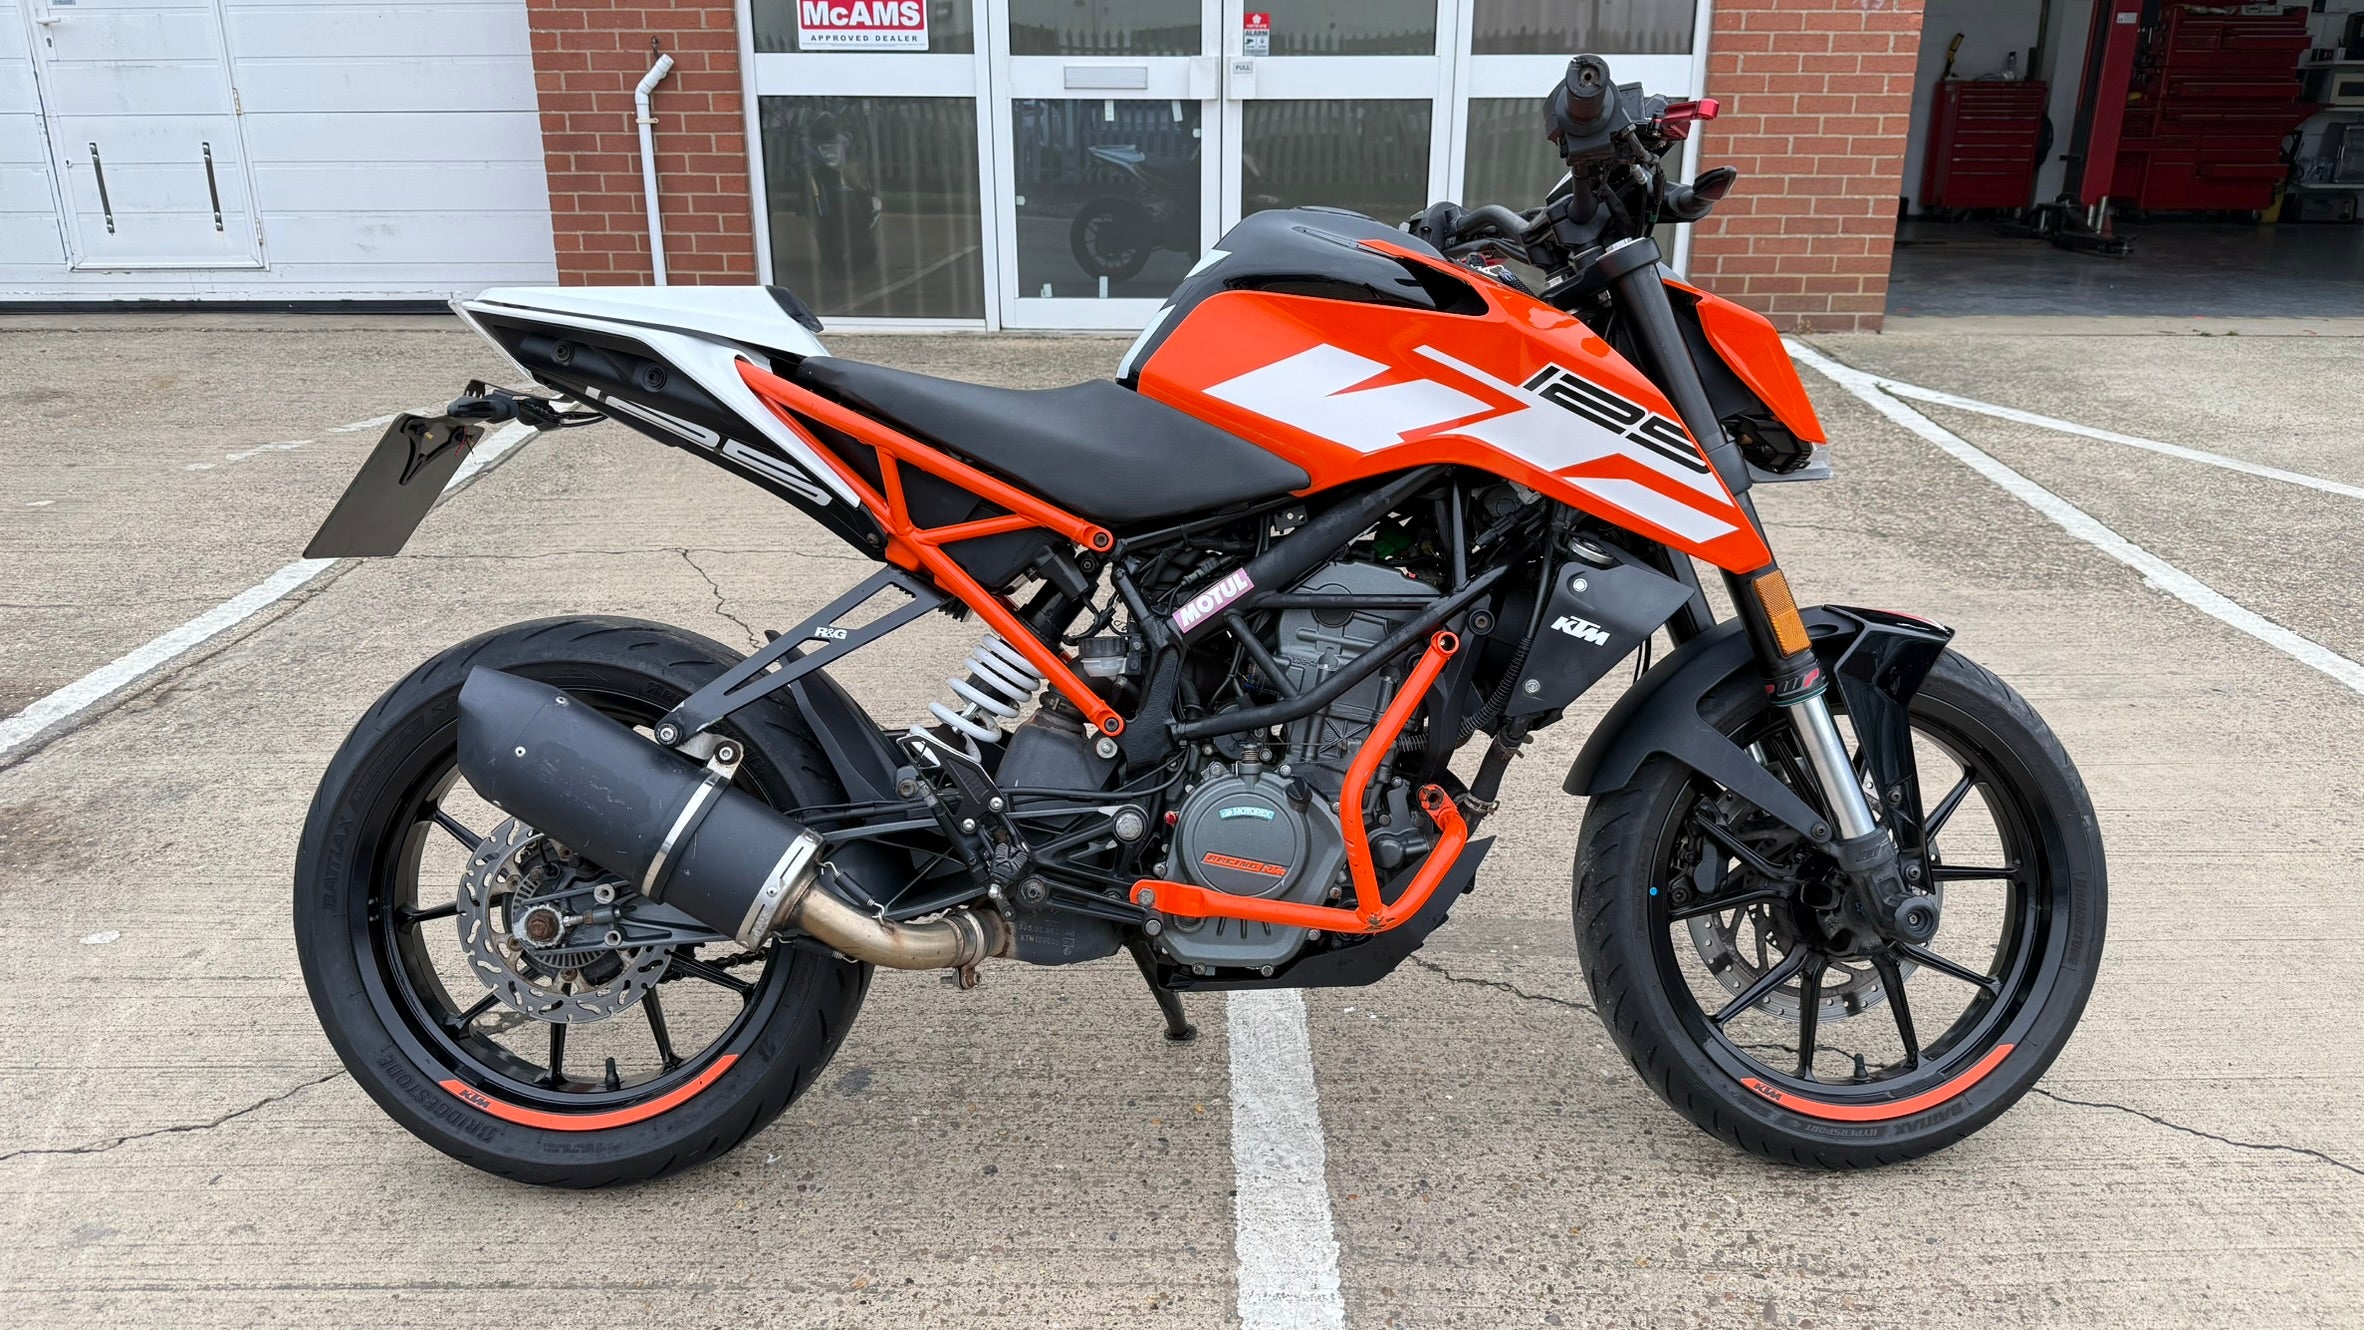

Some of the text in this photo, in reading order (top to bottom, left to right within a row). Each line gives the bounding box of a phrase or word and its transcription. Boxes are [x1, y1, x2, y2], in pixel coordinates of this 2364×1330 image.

[802, 0, 921, 27] McAMS
[810, 34, 869, 42] APPROVED
[1523, 365, 1713, 475] 125
[1179, 573, 1249, 628] MOTUL
[814, 626, 848, 640] R&G
[1550, 615, 1611, 647] KTM
[460, 1089, 491, 1108] KTM
[1753, 1082, 1782, 1101] KTM
[1804, 1123, 1879, 1138] HYPERSPORT
